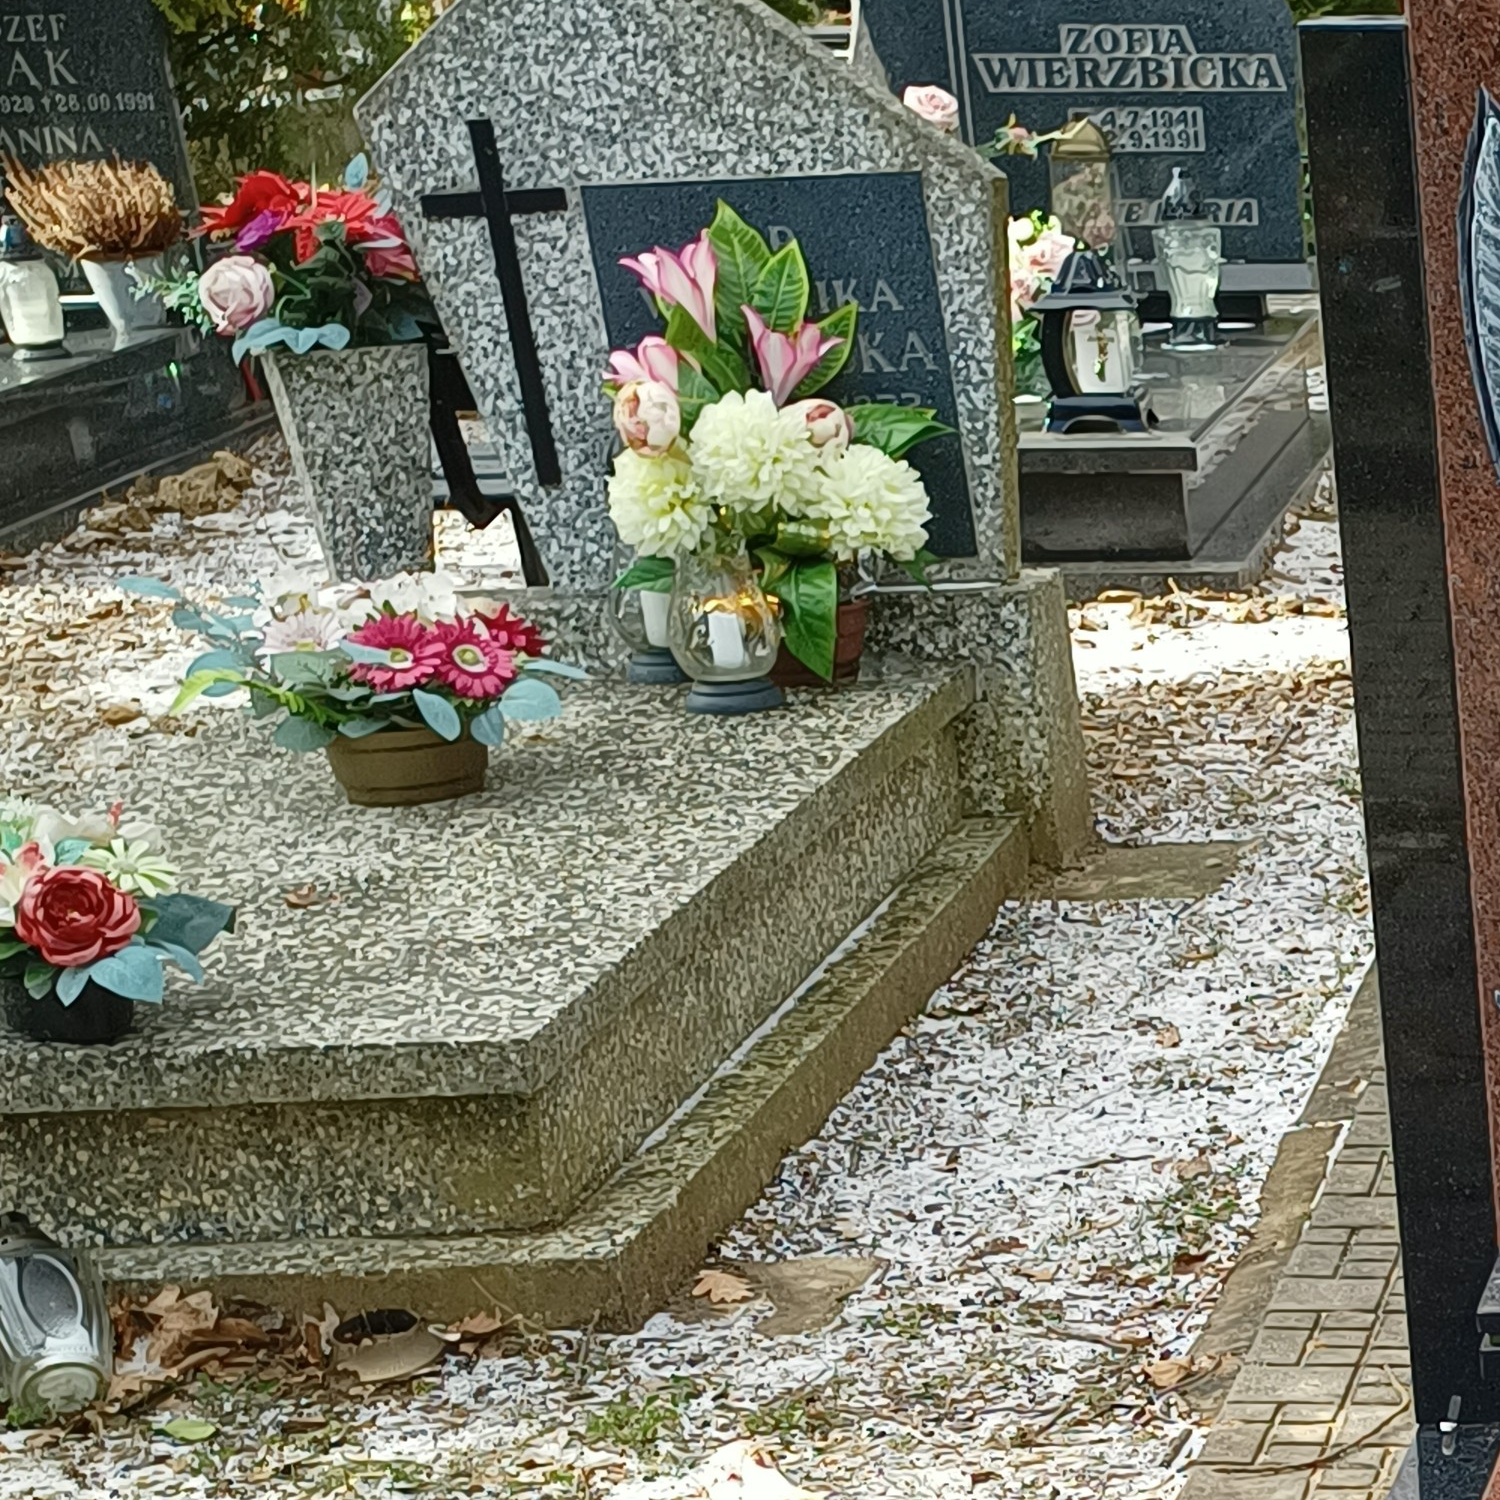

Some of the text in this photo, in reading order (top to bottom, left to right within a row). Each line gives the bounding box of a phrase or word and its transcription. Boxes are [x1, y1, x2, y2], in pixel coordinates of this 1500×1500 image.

[0, 14, 67, 42] ZEF
[1064, 27, 1190, 54] ZOFIA
[980, 57, 1282, 89] WIERZBICKA
